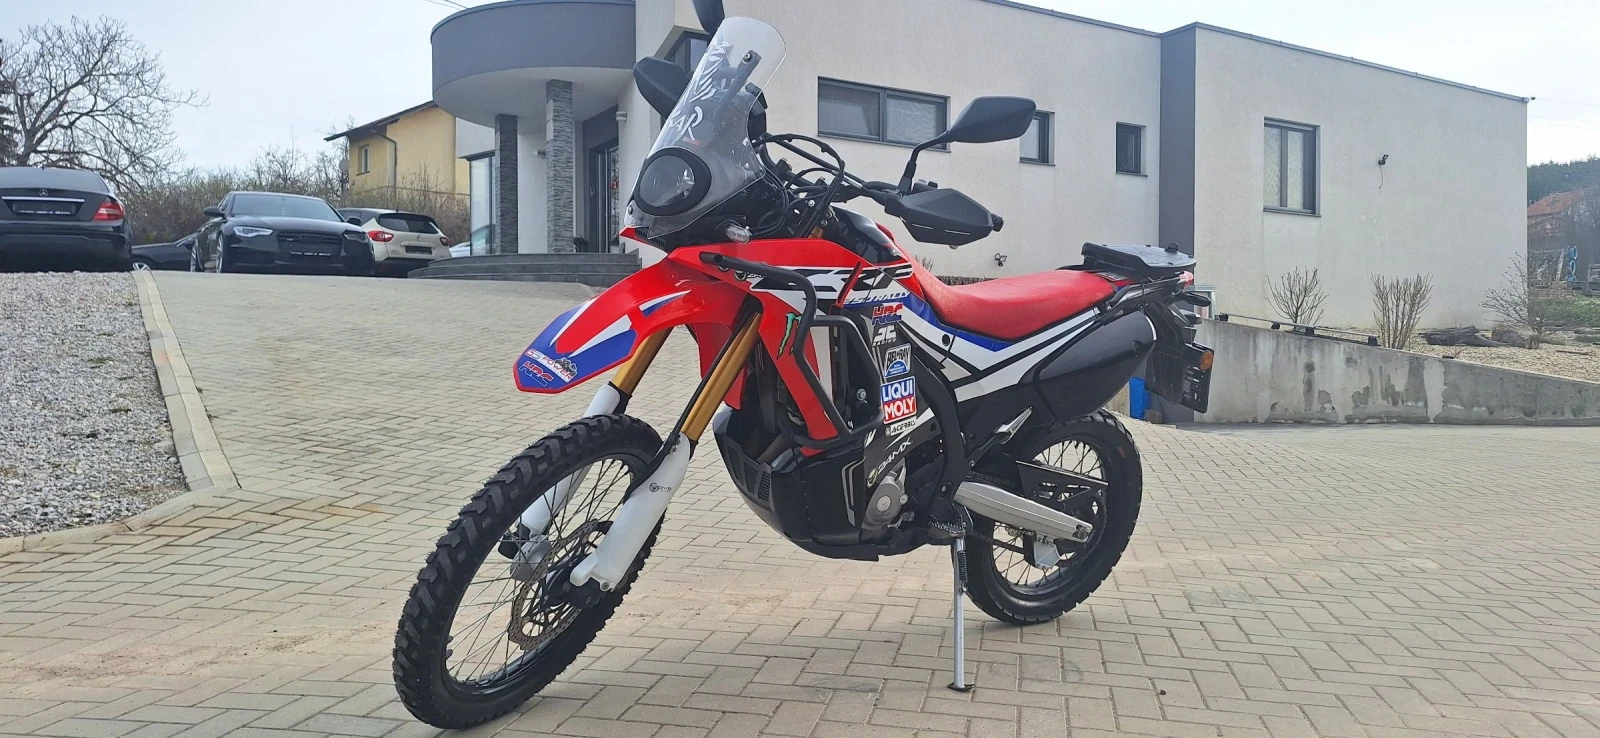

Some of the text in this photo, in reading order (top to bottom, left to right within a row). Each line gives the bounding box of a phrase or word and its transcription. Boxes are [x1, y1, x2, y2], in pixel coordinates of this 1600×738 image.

[872, 303, 904, 326] HRC
[519, 361, 554, 387] HRC
[882, 380, 914, 402] LIQUI
[883, 396, 916, 421] MOLY
